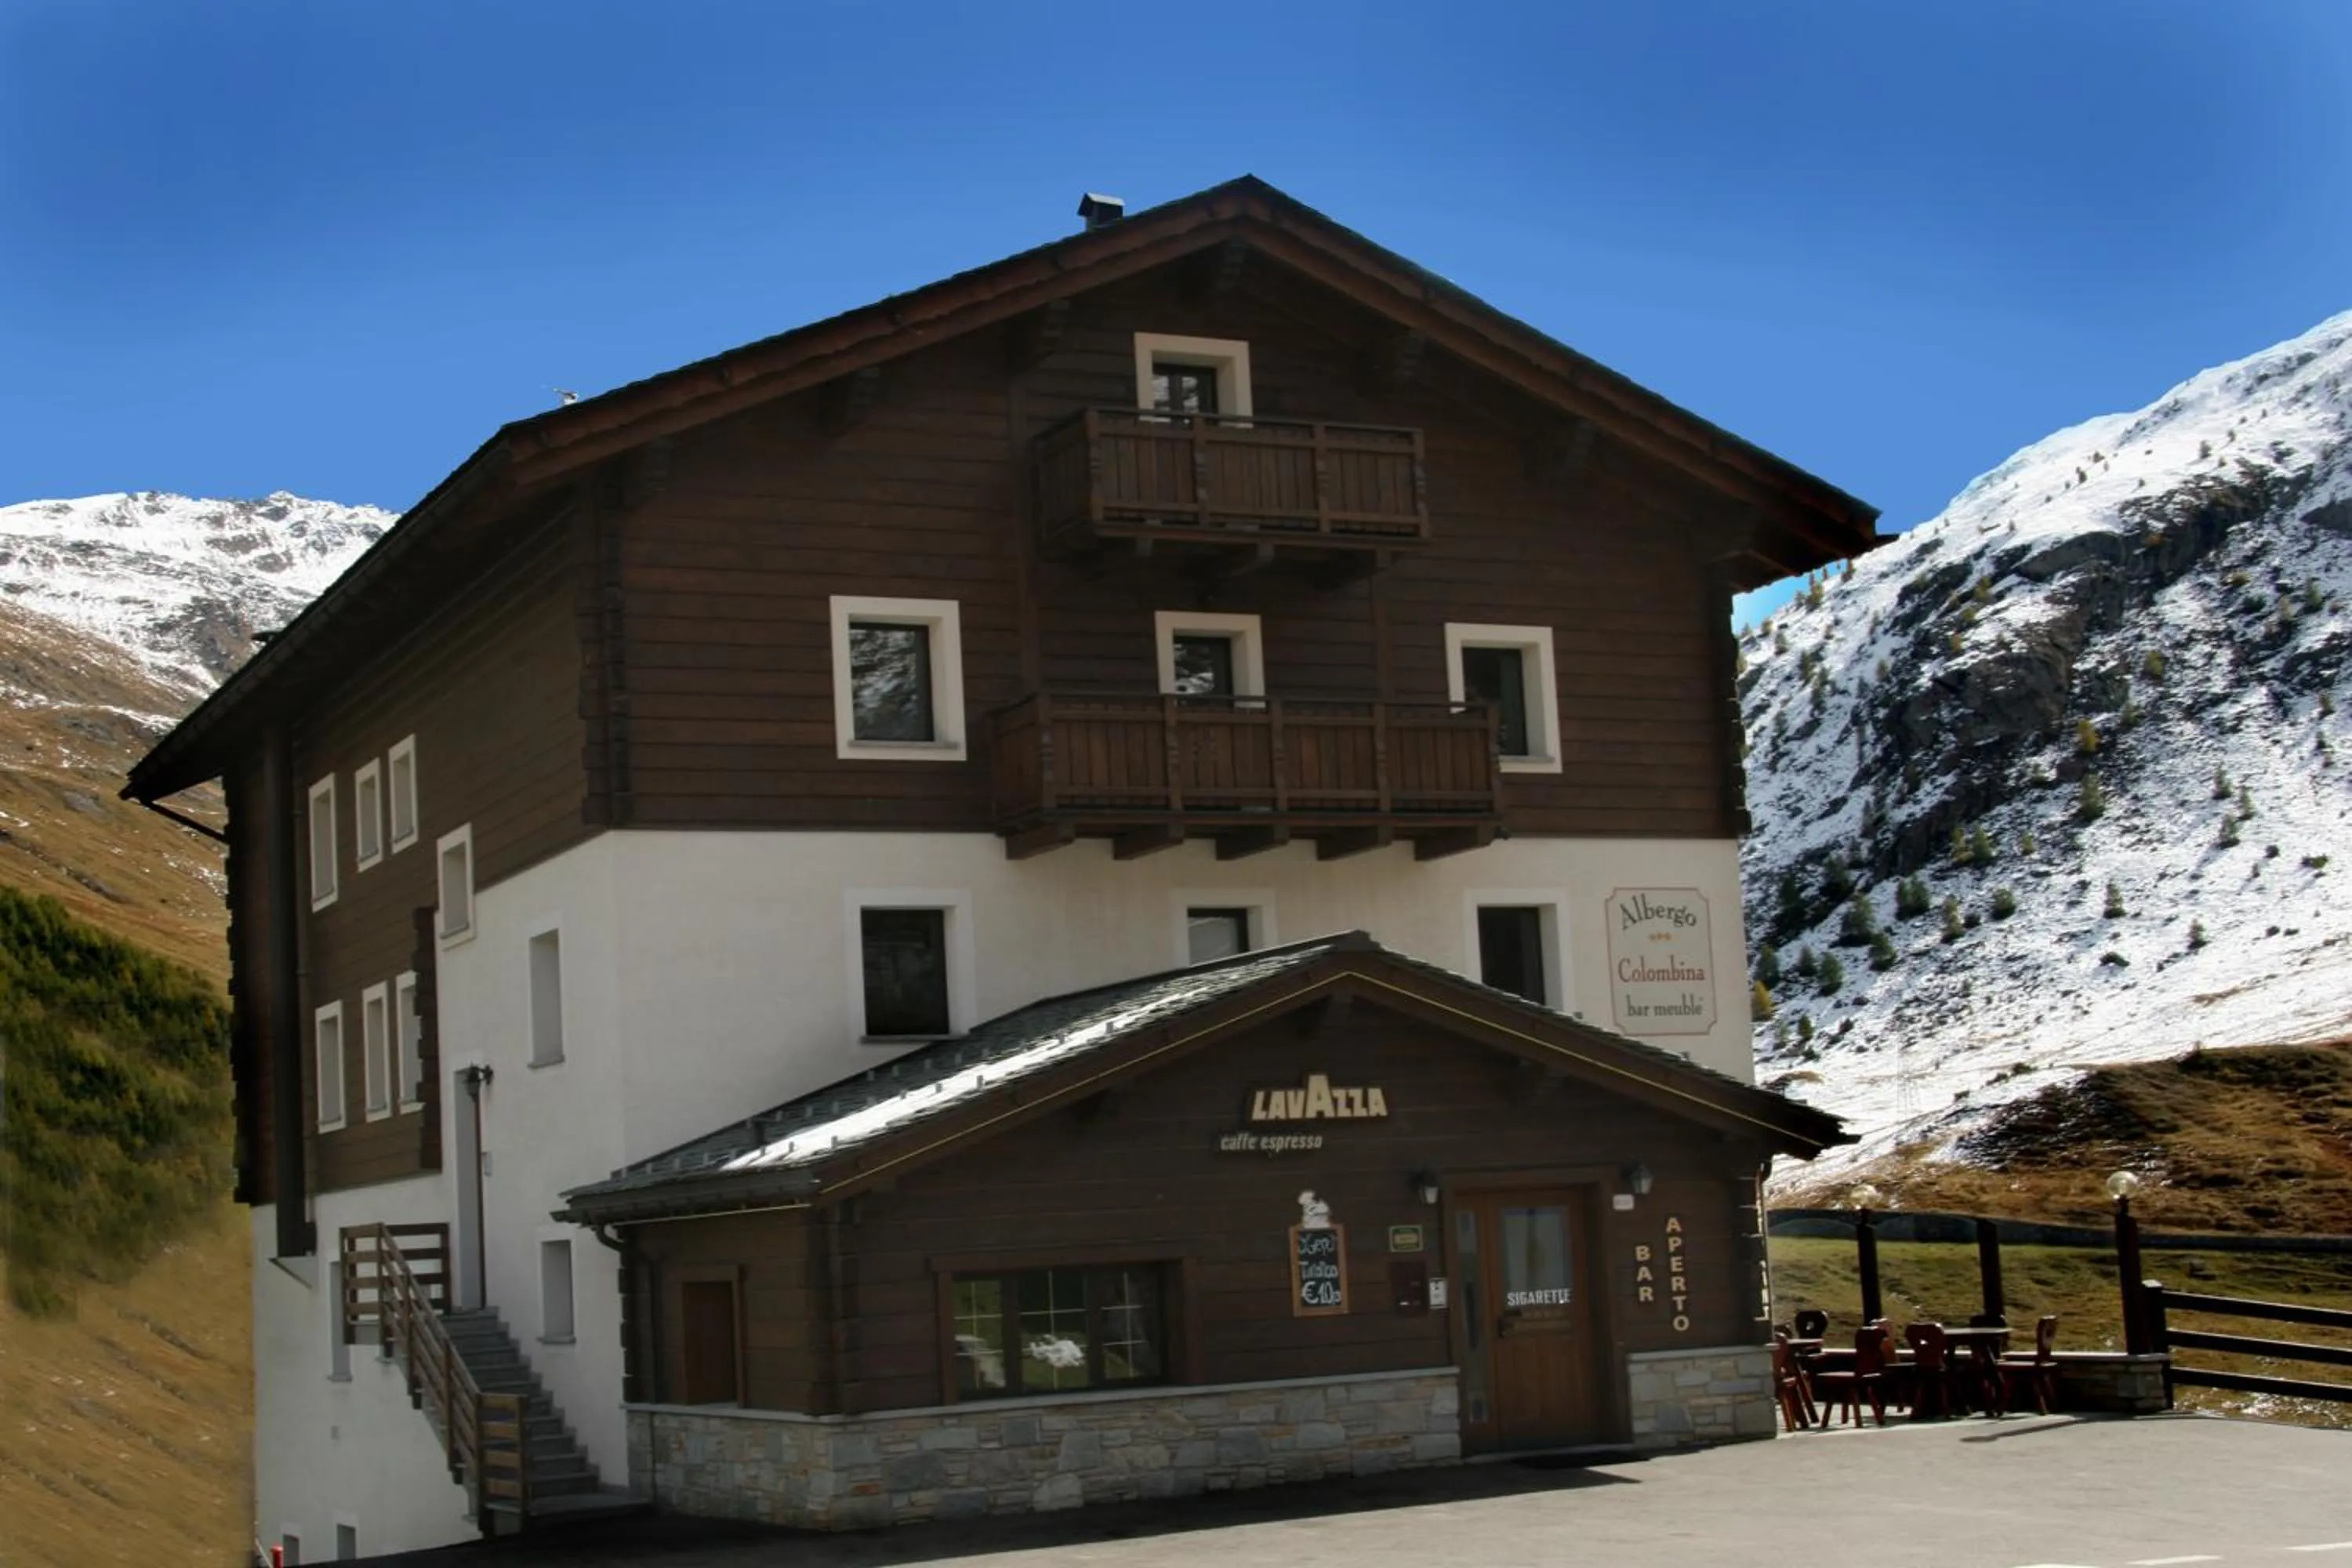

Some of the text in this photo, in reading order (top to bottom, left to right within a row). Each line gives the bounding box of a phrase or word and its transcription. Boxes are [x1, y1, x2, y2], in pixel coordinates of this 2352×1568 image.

[1619, 893, 1697, 931] Albergo
[1617, 954, 1705, 982] Colombina
[1626, 993, 1649, 1017] bar
[1251, 1074, 1388, 1120] LAVAZZA
[1260, 1134, 1323, 1153] espresso
[1635, 1245, 1654, 1302] BAR
[1665, 1216, 1690, 1331] APERTO
[1507, 1288, 1572, 1305] SIGARETTE
